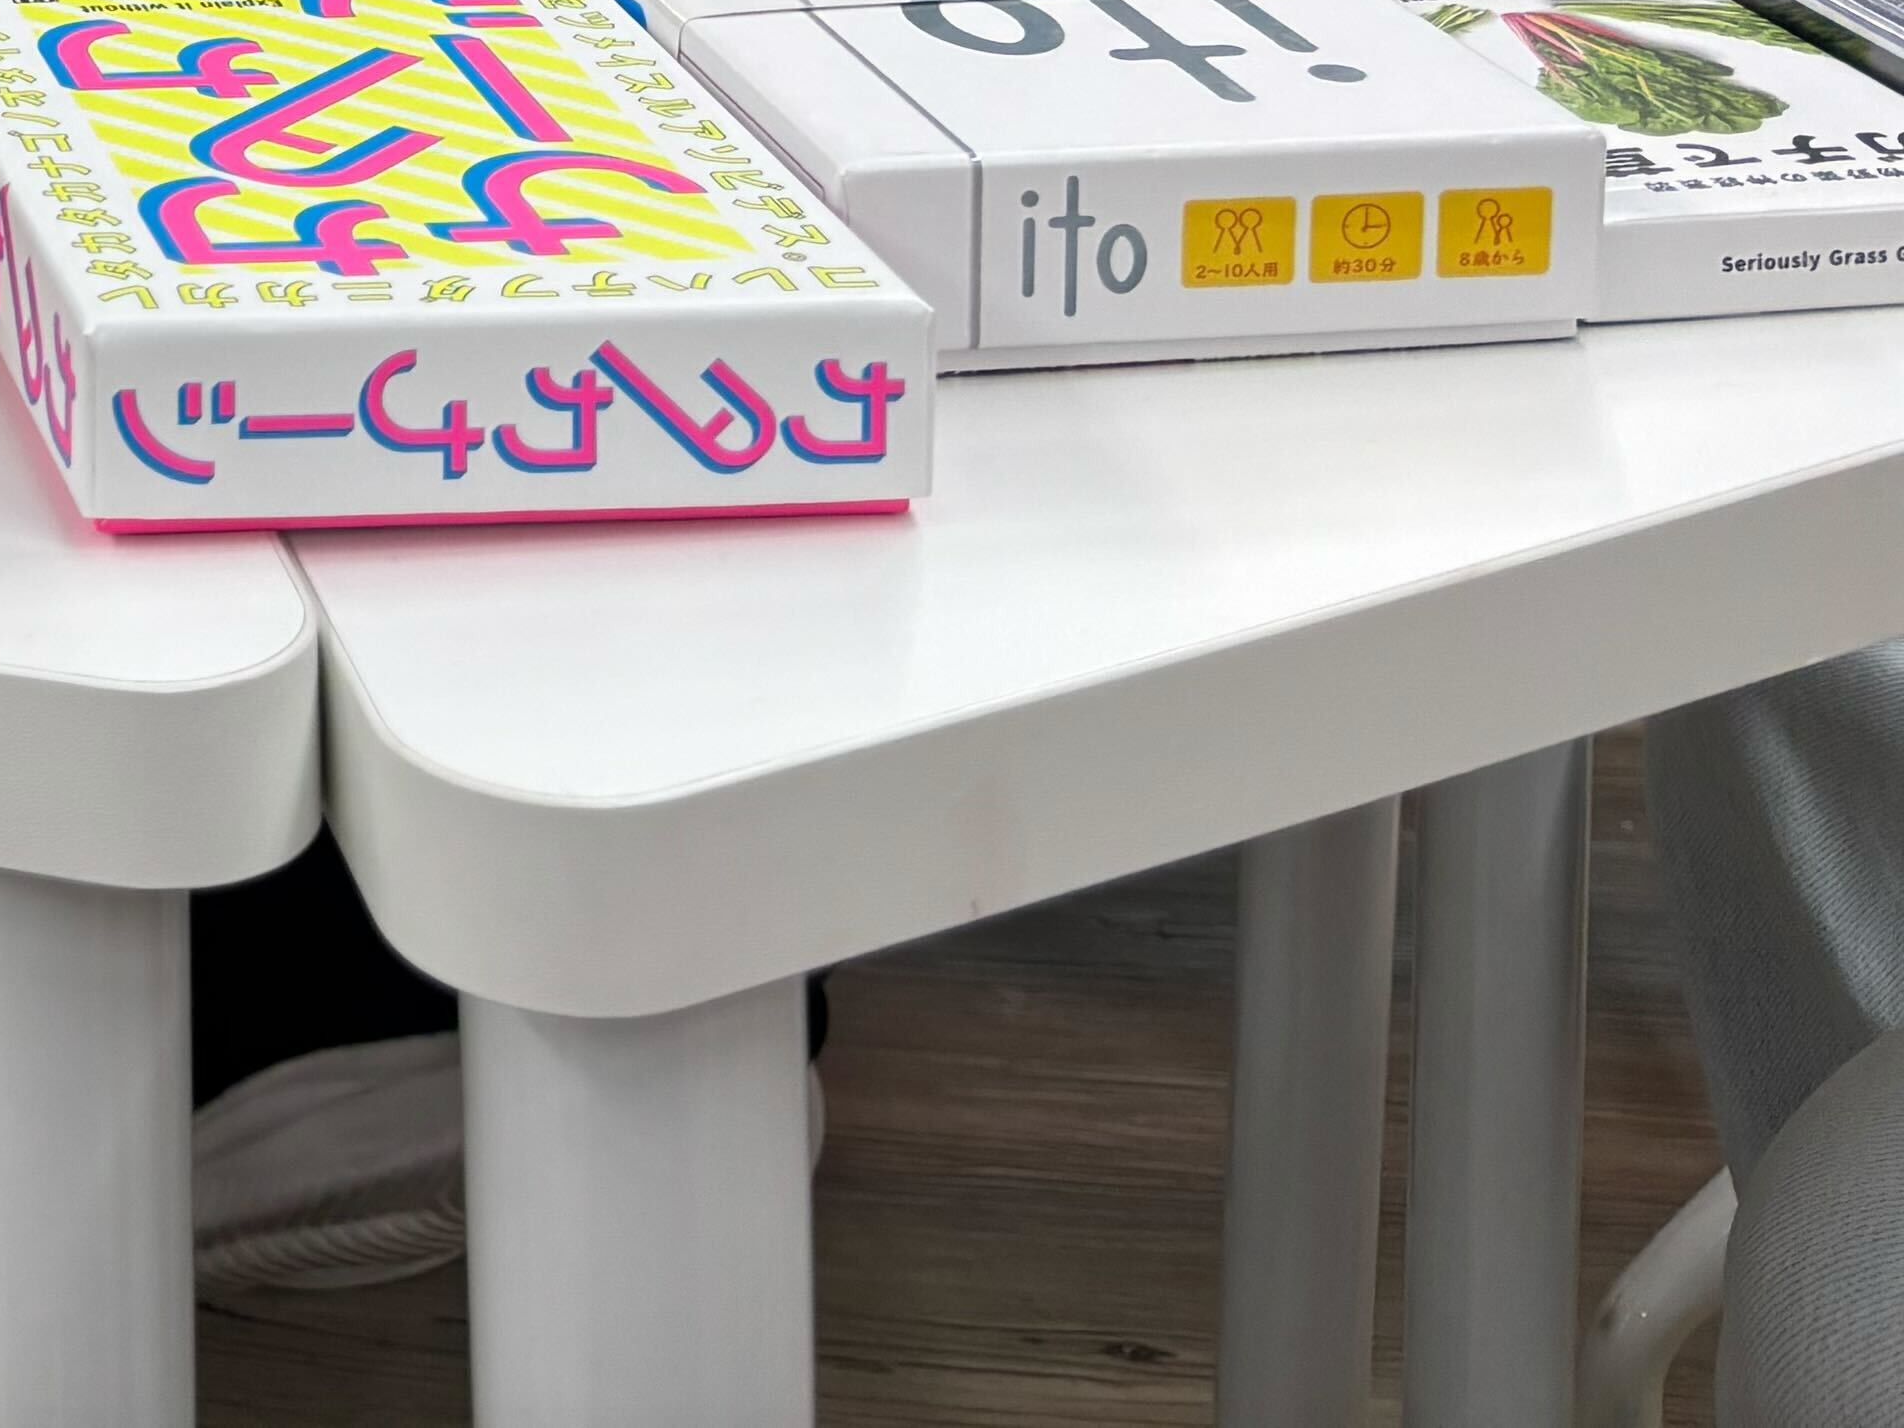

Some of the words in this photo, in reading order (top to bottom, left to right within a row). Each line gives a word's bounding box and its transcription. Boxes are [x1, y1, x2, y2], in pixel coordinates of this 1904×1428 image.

[80, 2, 169, 13] without
[1021, 175, 1147, 317] ito
[1332, 257, 1397, 276] 約30分
[1459, 248, 1526, 267] 8歳から
[1720, 250, 1821, 273] Seriously
[1828, 248, 1888, 267] Grass
[111, 337, 907, 487] カタカナーシ
